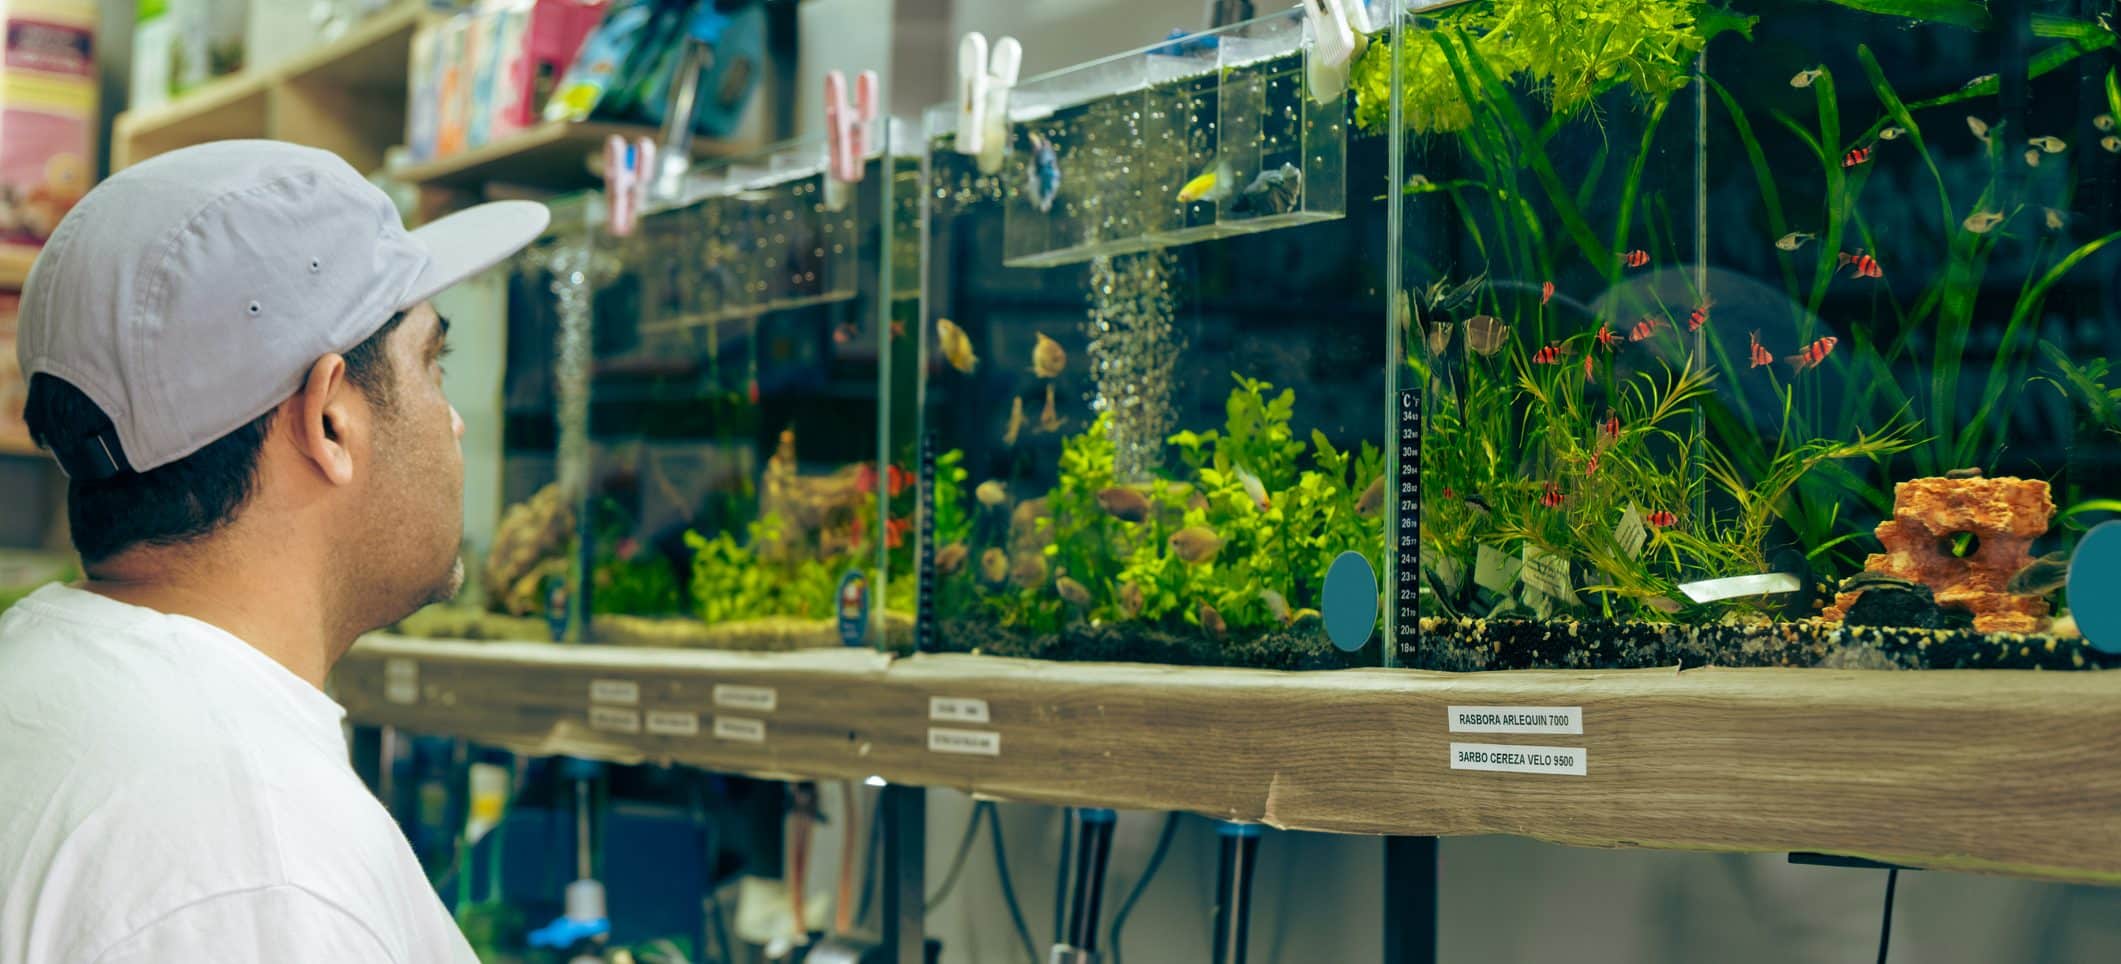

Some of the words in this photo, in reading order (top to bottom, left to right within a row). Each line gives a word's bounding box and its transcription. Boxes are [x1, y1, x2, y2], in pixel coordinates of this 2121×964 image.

[1459, 714, 1501, 726] RASBORA
[1502, 714, 1547, 726] ARLEQUIN
[1549, 715, 1569, 726] 7000
[1490, 753, 1526, 765] CEREZA
[1527, 754, 1552, 766] VELO
[1554, 756, 1574, 767] 9500
